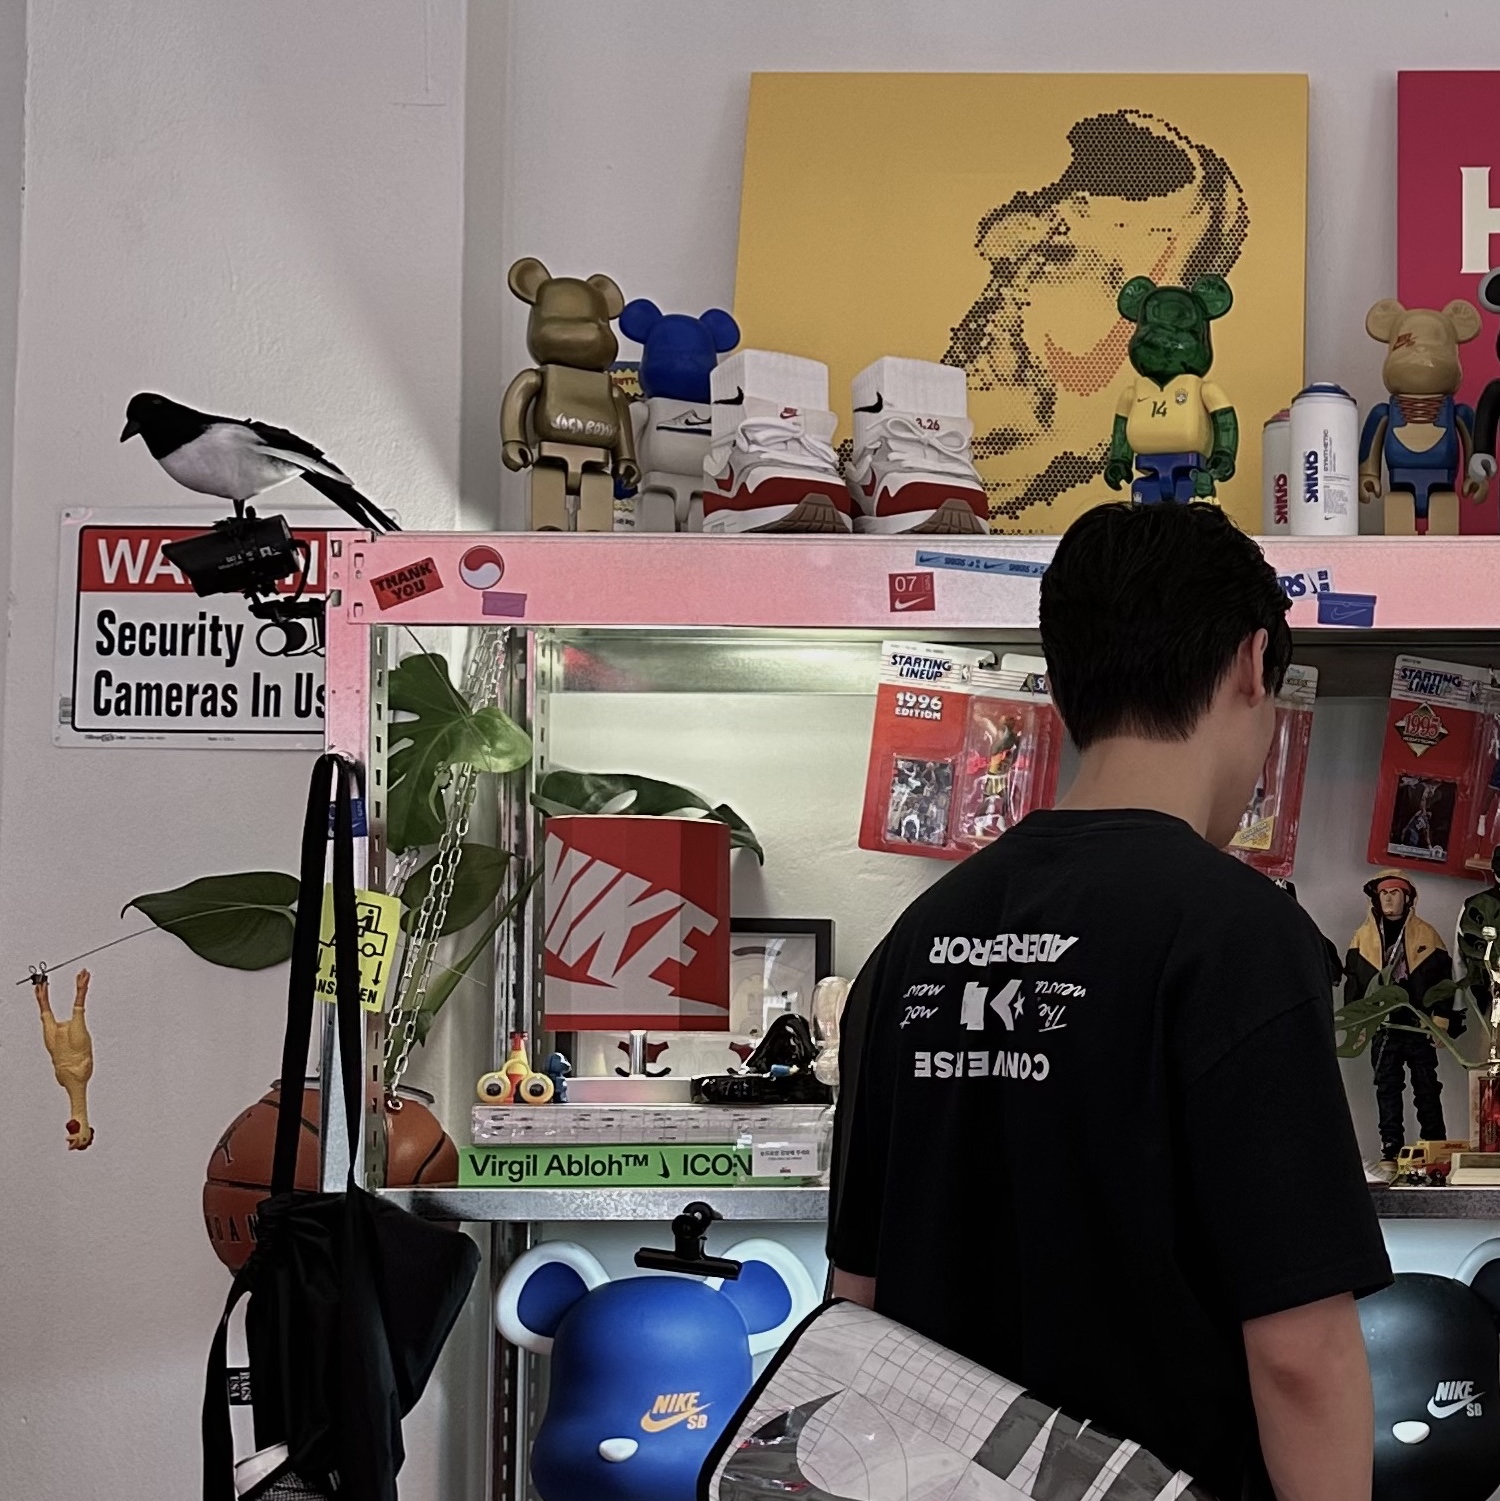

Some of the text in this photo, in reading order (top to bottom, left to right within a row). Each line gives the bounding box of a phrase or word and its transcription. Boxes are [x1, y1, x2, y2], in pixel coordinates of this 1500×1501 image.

[1150, 402, 1168, 419] 14
[1305, 451, 1318, 503] SNKRS
[1274, 474, 1287, 525] SNKRS
[377, 562, 432, 592] THANK
[895, 576, 917, 592] 07
[392, 578, 426, 600] YOU
[96, 609, 244, 667] Security
[890, 654, 951, 672] STARTING
[899, 666, 943, 682] LINEUP
[1400, 667, 1462, 688] STARTING
[93, 669, 325, 718] Cameras In Us
[896, 692, 943, 710] 1996
[895, 707, 942, 721] EDITION
[1404, 713, 1442, 738] 1995
[903, 984, 946, 998] new
[900, 1006, 939, 1030] not
[1038, 1003, 1067, 1032] The
[468, 1153, 538, 1182] Virgil
[682, 1154, 753, 1177] ICON
[229, 1375, 241, 1398] USA
[239, 1371, 252, 1401] BAGS
[1434, 1381, 1475, 1402] NIKE
[653, 1390, 700, 1415] NIKE
[1466, 1404, 1482, 1417] SB
[687, 1414, 708, 1430] SB
